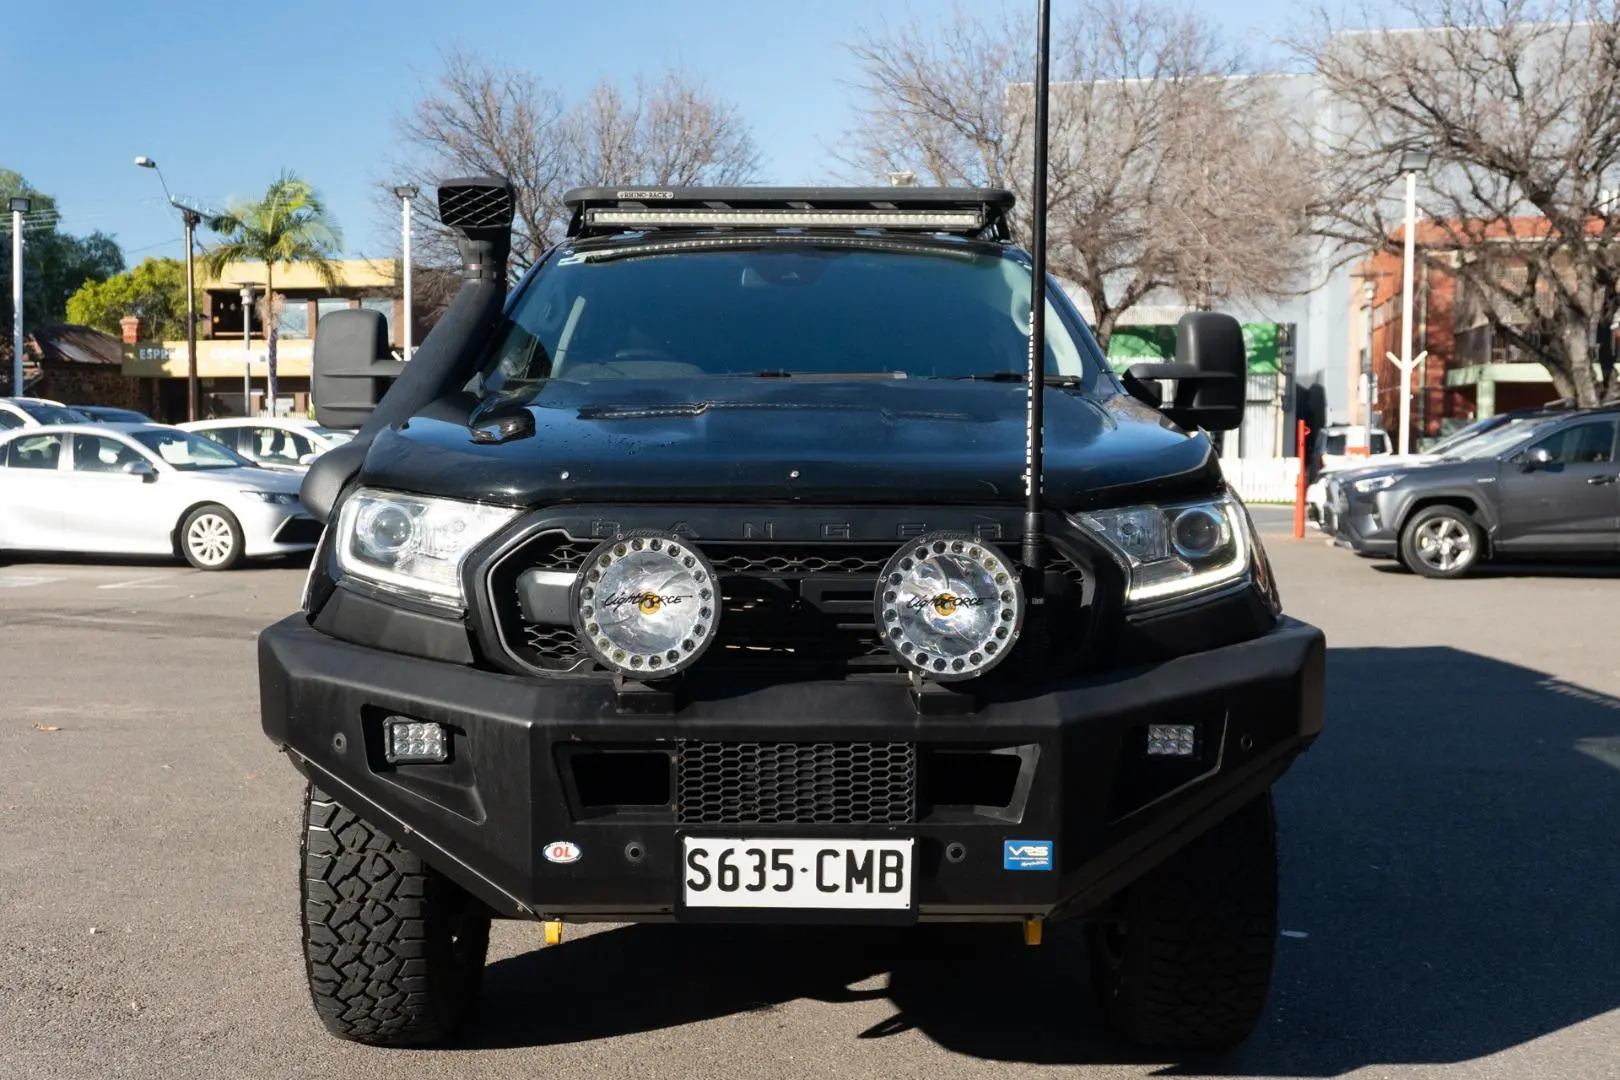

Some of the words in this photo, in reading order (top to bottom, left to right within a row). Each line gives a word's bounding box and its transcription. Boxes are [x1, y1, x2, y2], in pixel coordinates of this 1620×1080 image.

[592, 519, 1002, 539] RANGER
[553, 846, 573, 858] OL
[1008, 846, 1049, 856] VRS
